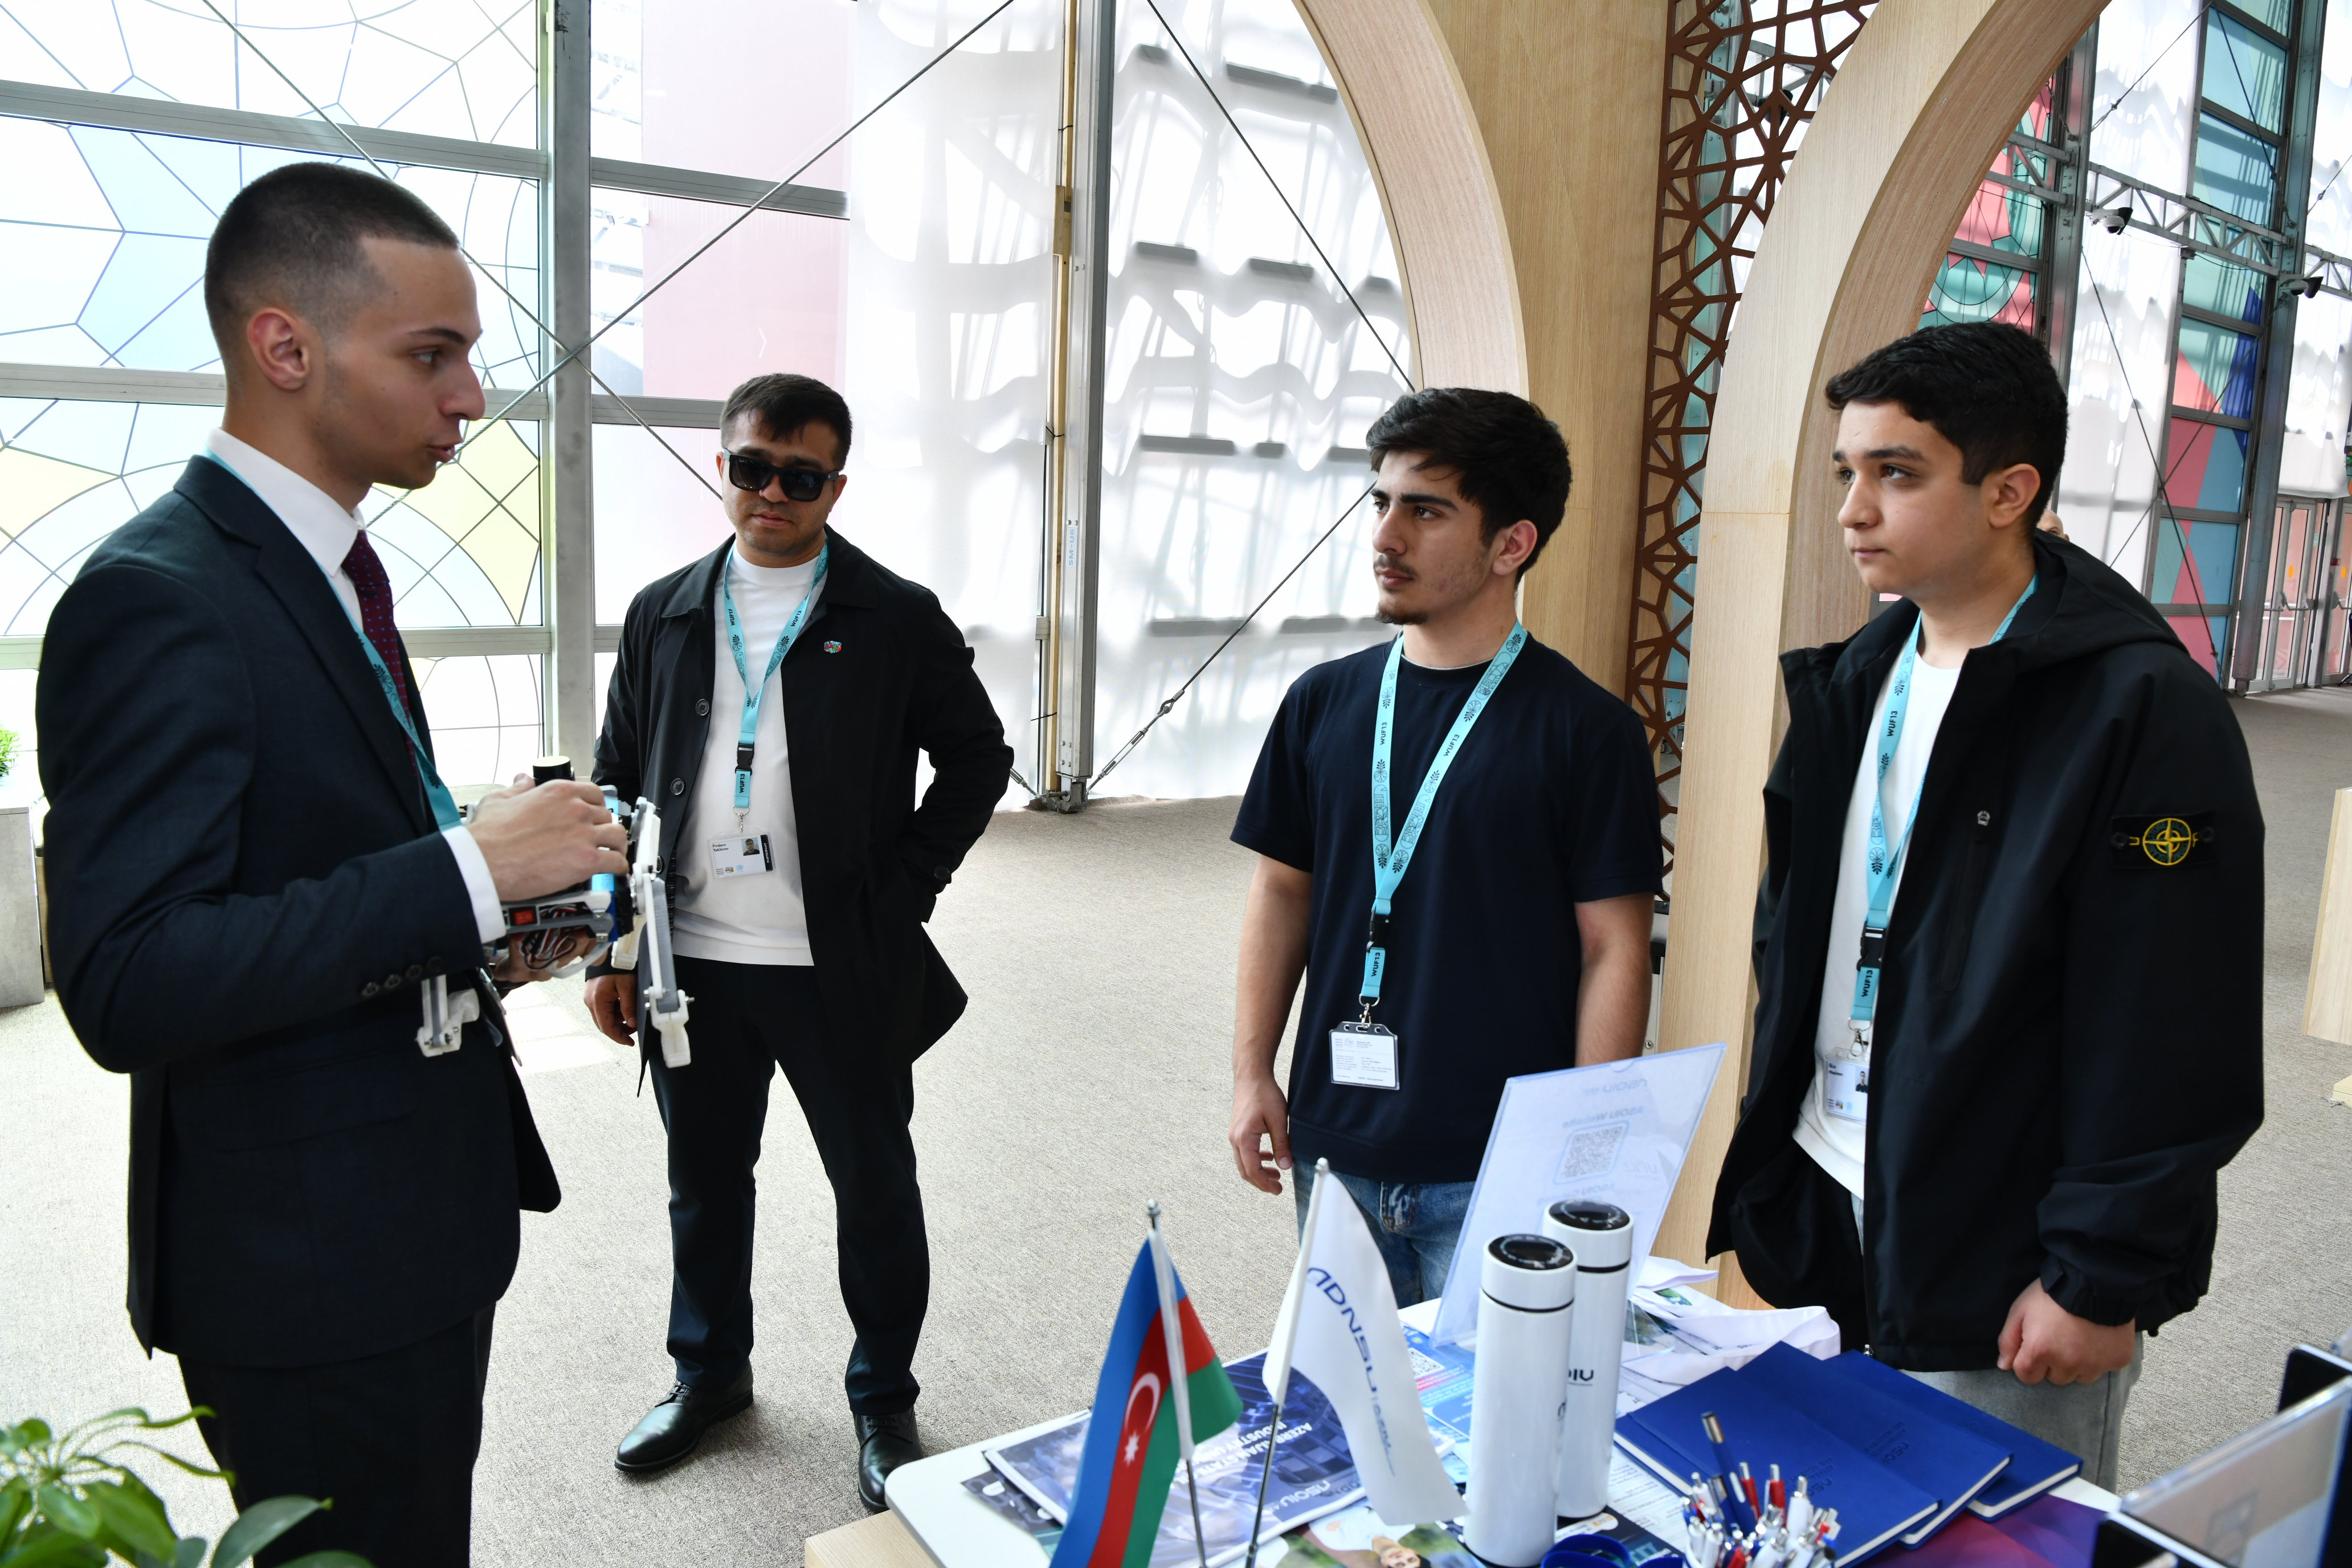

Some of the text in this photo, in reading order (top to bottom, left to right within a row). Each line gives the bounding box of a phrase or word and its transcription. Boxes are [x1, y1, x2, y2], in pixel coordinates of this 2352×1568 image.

[790, 610, 802, 627] WUF13
[1886, 710, 1898, 737] WUF13
[1443, 734, 1460, 757] WUF13
[1371, 952, 1381, 977] WUF13
[1861, 970, 1873, 997] WUF13
